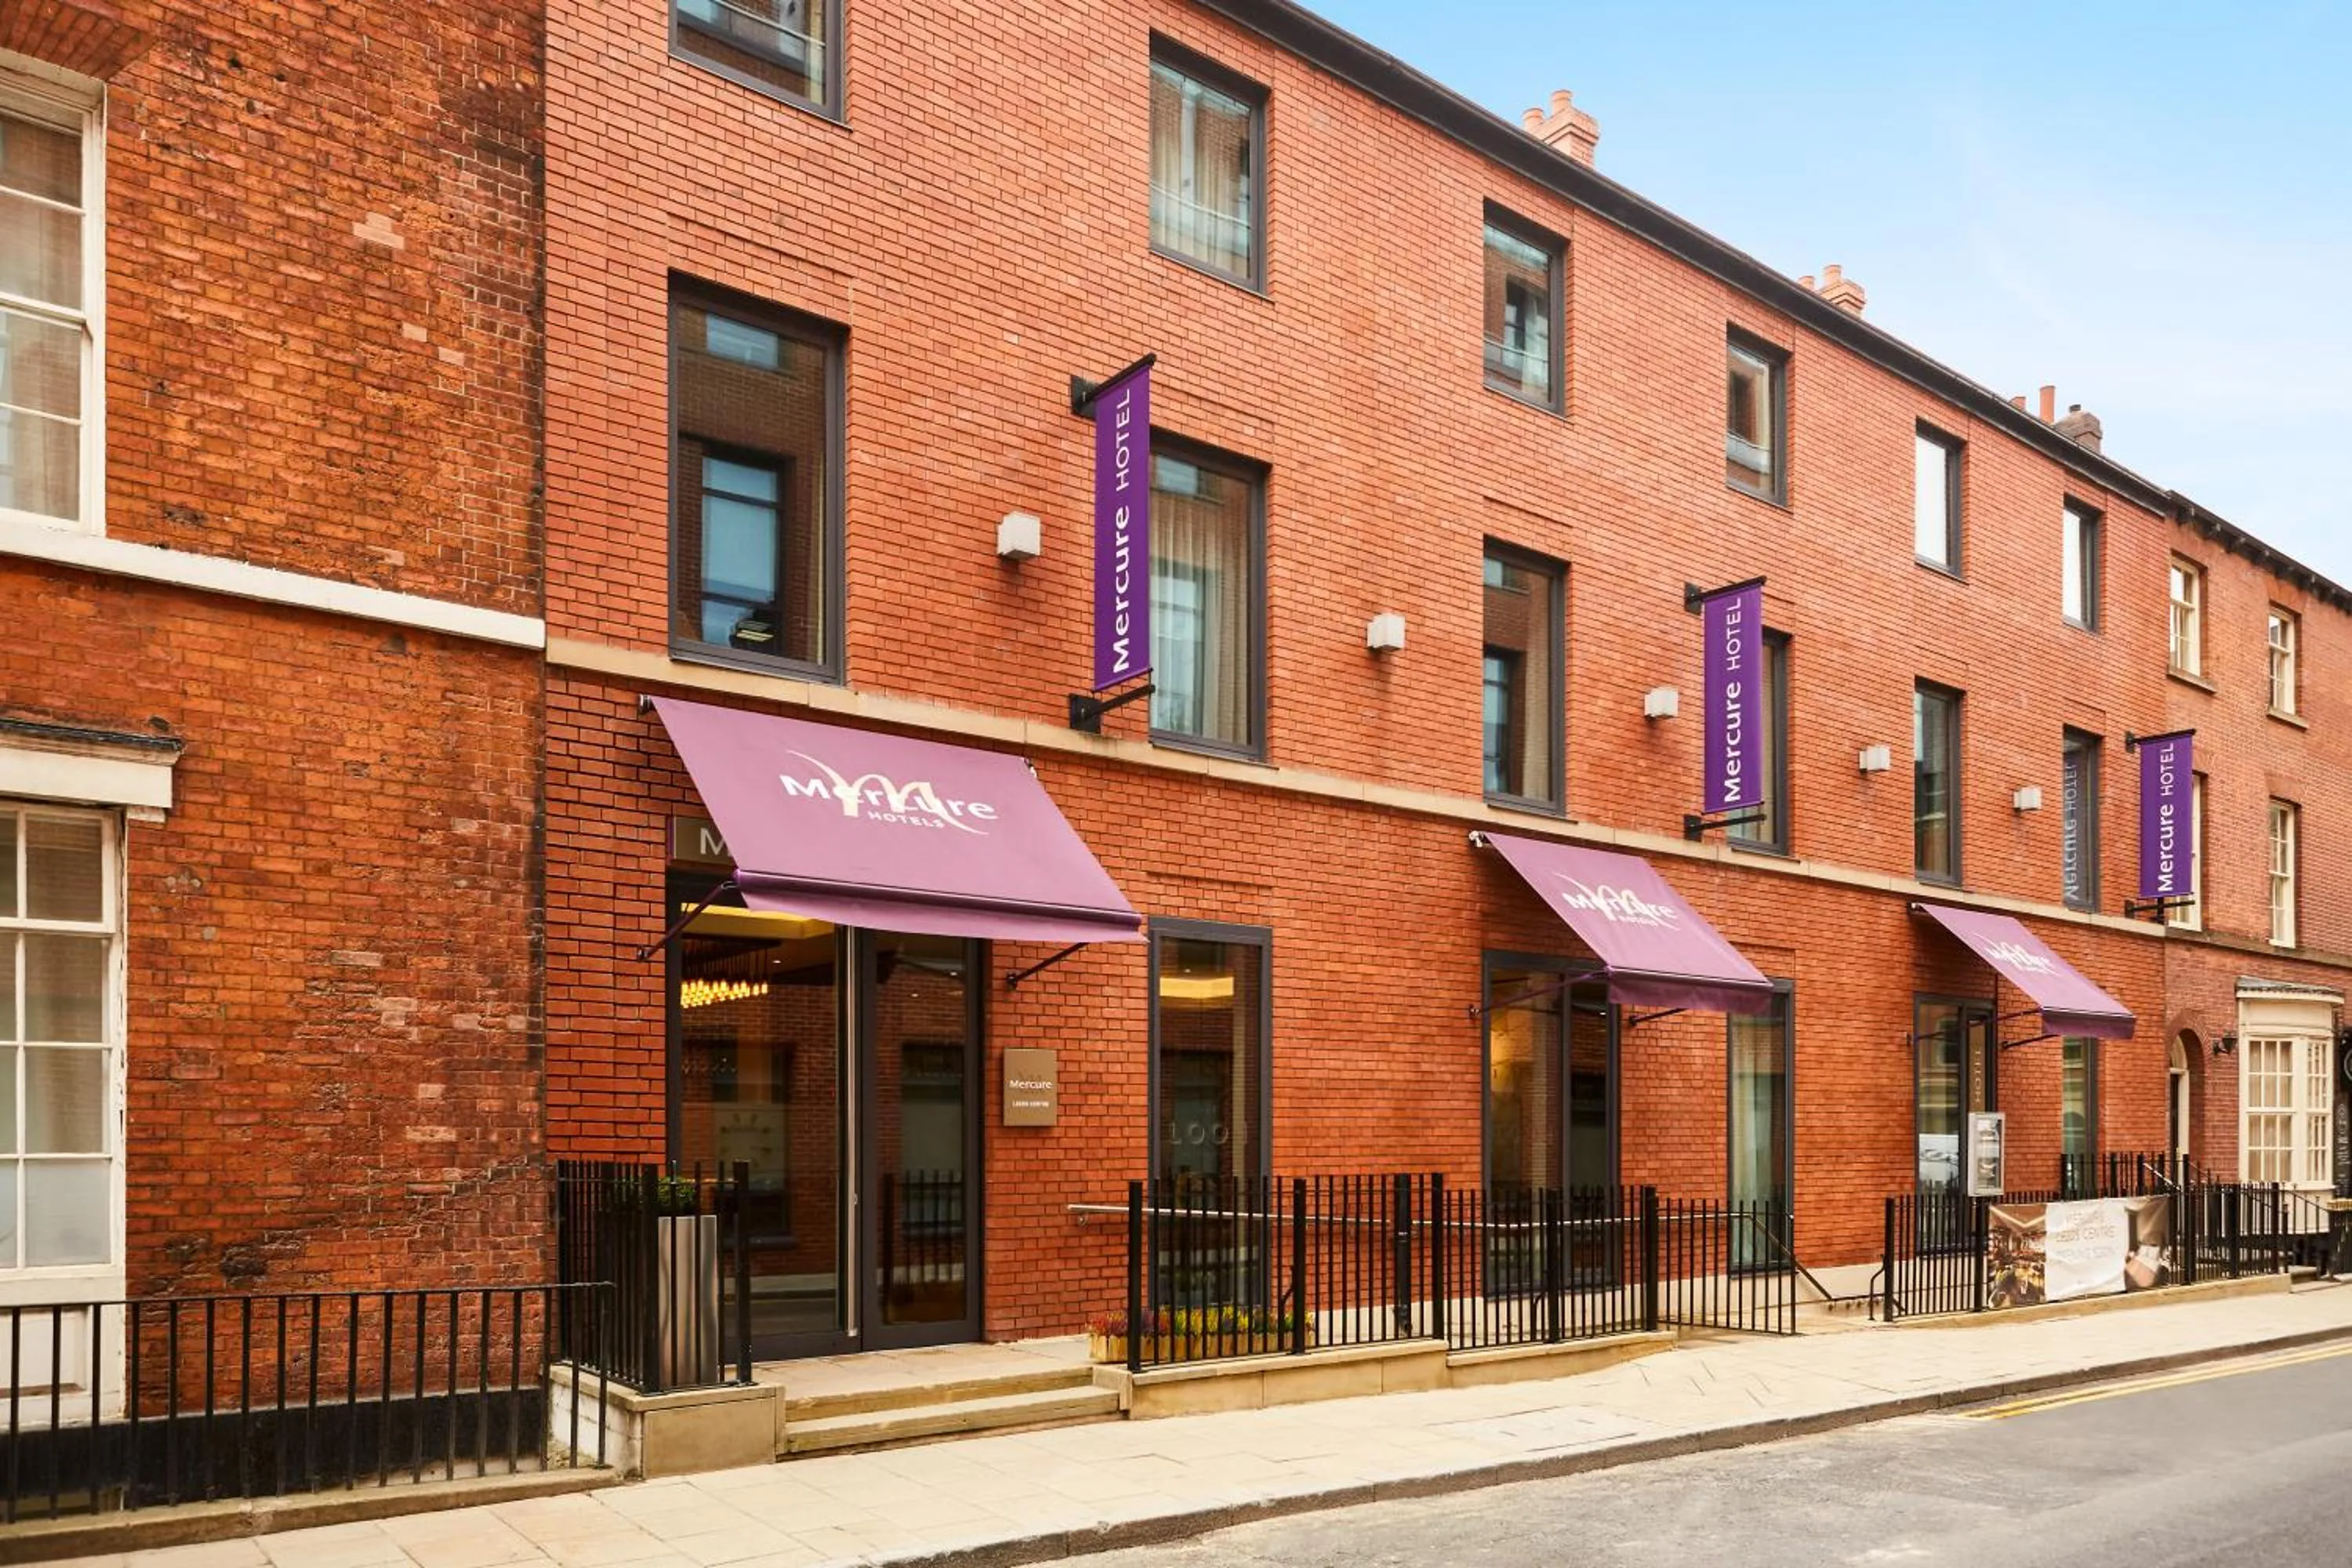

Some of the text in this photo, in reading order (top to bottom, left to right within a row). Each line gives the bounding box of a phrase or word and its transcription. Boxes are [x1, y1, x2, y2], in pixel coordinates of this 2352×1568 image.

[1112, 388, 1129, 673] Mercure HOTEL
[1724, 597, 1741, 803] Mercure HOTEL
[867, 809, 946, 829] HOTELS
[2158, 742, 2174, 892] Mercure HOTEL
[1009, 1079, 1054, 1089] Mercure
